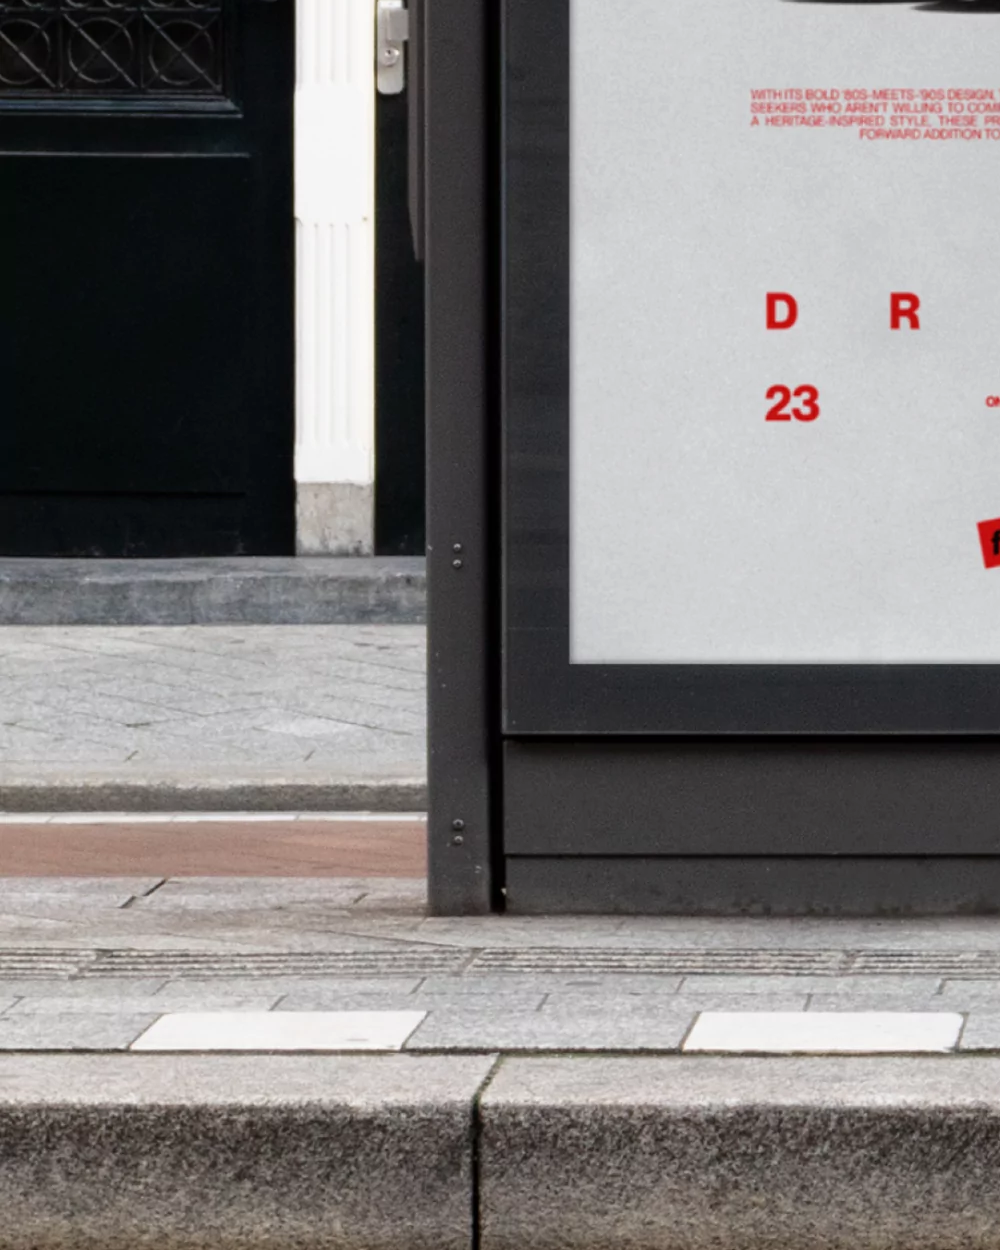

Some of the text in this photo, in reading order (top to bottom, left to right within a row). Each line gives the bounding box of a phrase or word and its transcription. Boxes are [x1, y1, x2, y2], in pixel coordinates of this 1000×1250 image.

[750, 88, 782, 101] WITH
[805, 88, 840, 101] BOLD
[750, 101, 807, 114] SEEKERS
[811, 101, 842, 114] WHO
[845, 101, 888, 114] AREN'T
[892, 101, 943, 114] WILLING
[947, 101, 965, 114] TO
[750, 114, 760, 127] A
[765, 114, 885, 127] HERITAGE-INSPIRED
[939, 114, 978, 127] THESE
[859, 127, 921, 140] FORWARD
[923, 127, 982, 140] ADDITION
[764, 384, 821, 423] 23
